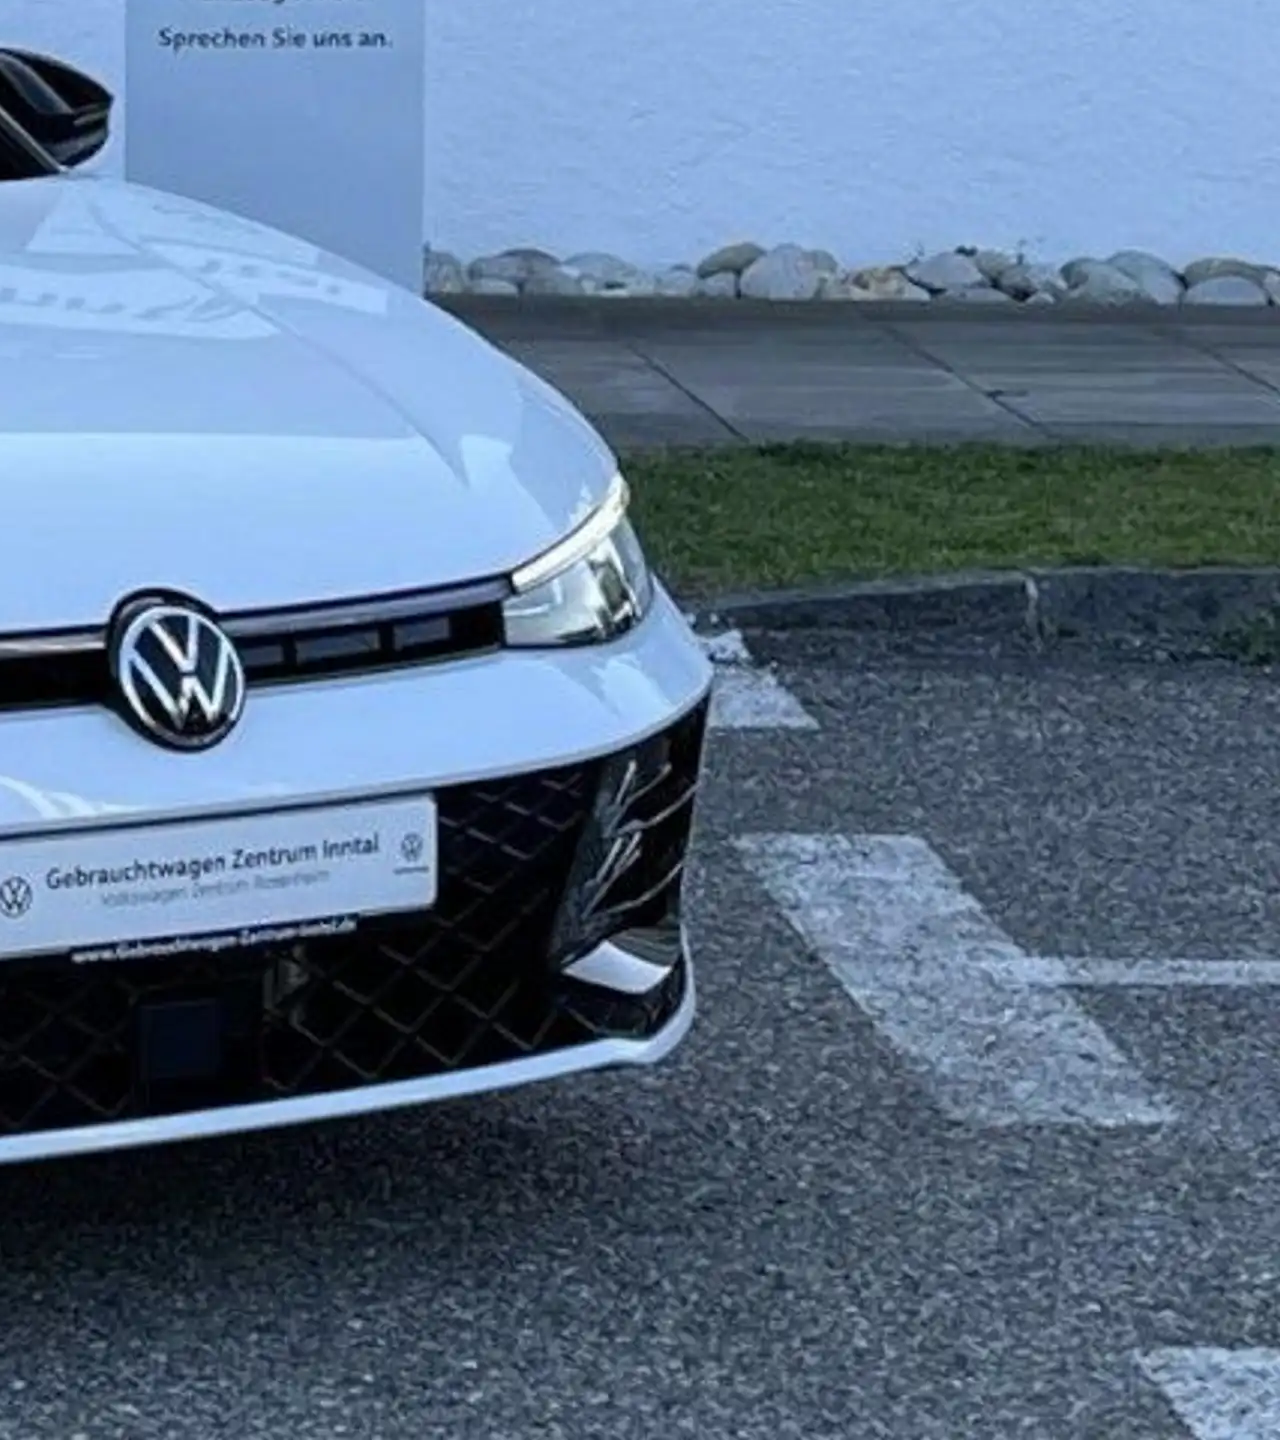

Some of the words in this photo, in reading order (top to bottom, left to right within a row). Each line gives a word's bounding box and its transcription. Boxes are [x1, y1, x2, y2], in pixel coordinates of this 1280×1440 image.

[159, 28, 265, 52] Sprechen
[272, 28, 305, 48] Sie
[313, 33, 352, 47] uns
[359, 33, 393, 46] an.
[46, 858, 226, 890] Gebrauchtwagen
[231, 844, 319, 870] Zentrum
